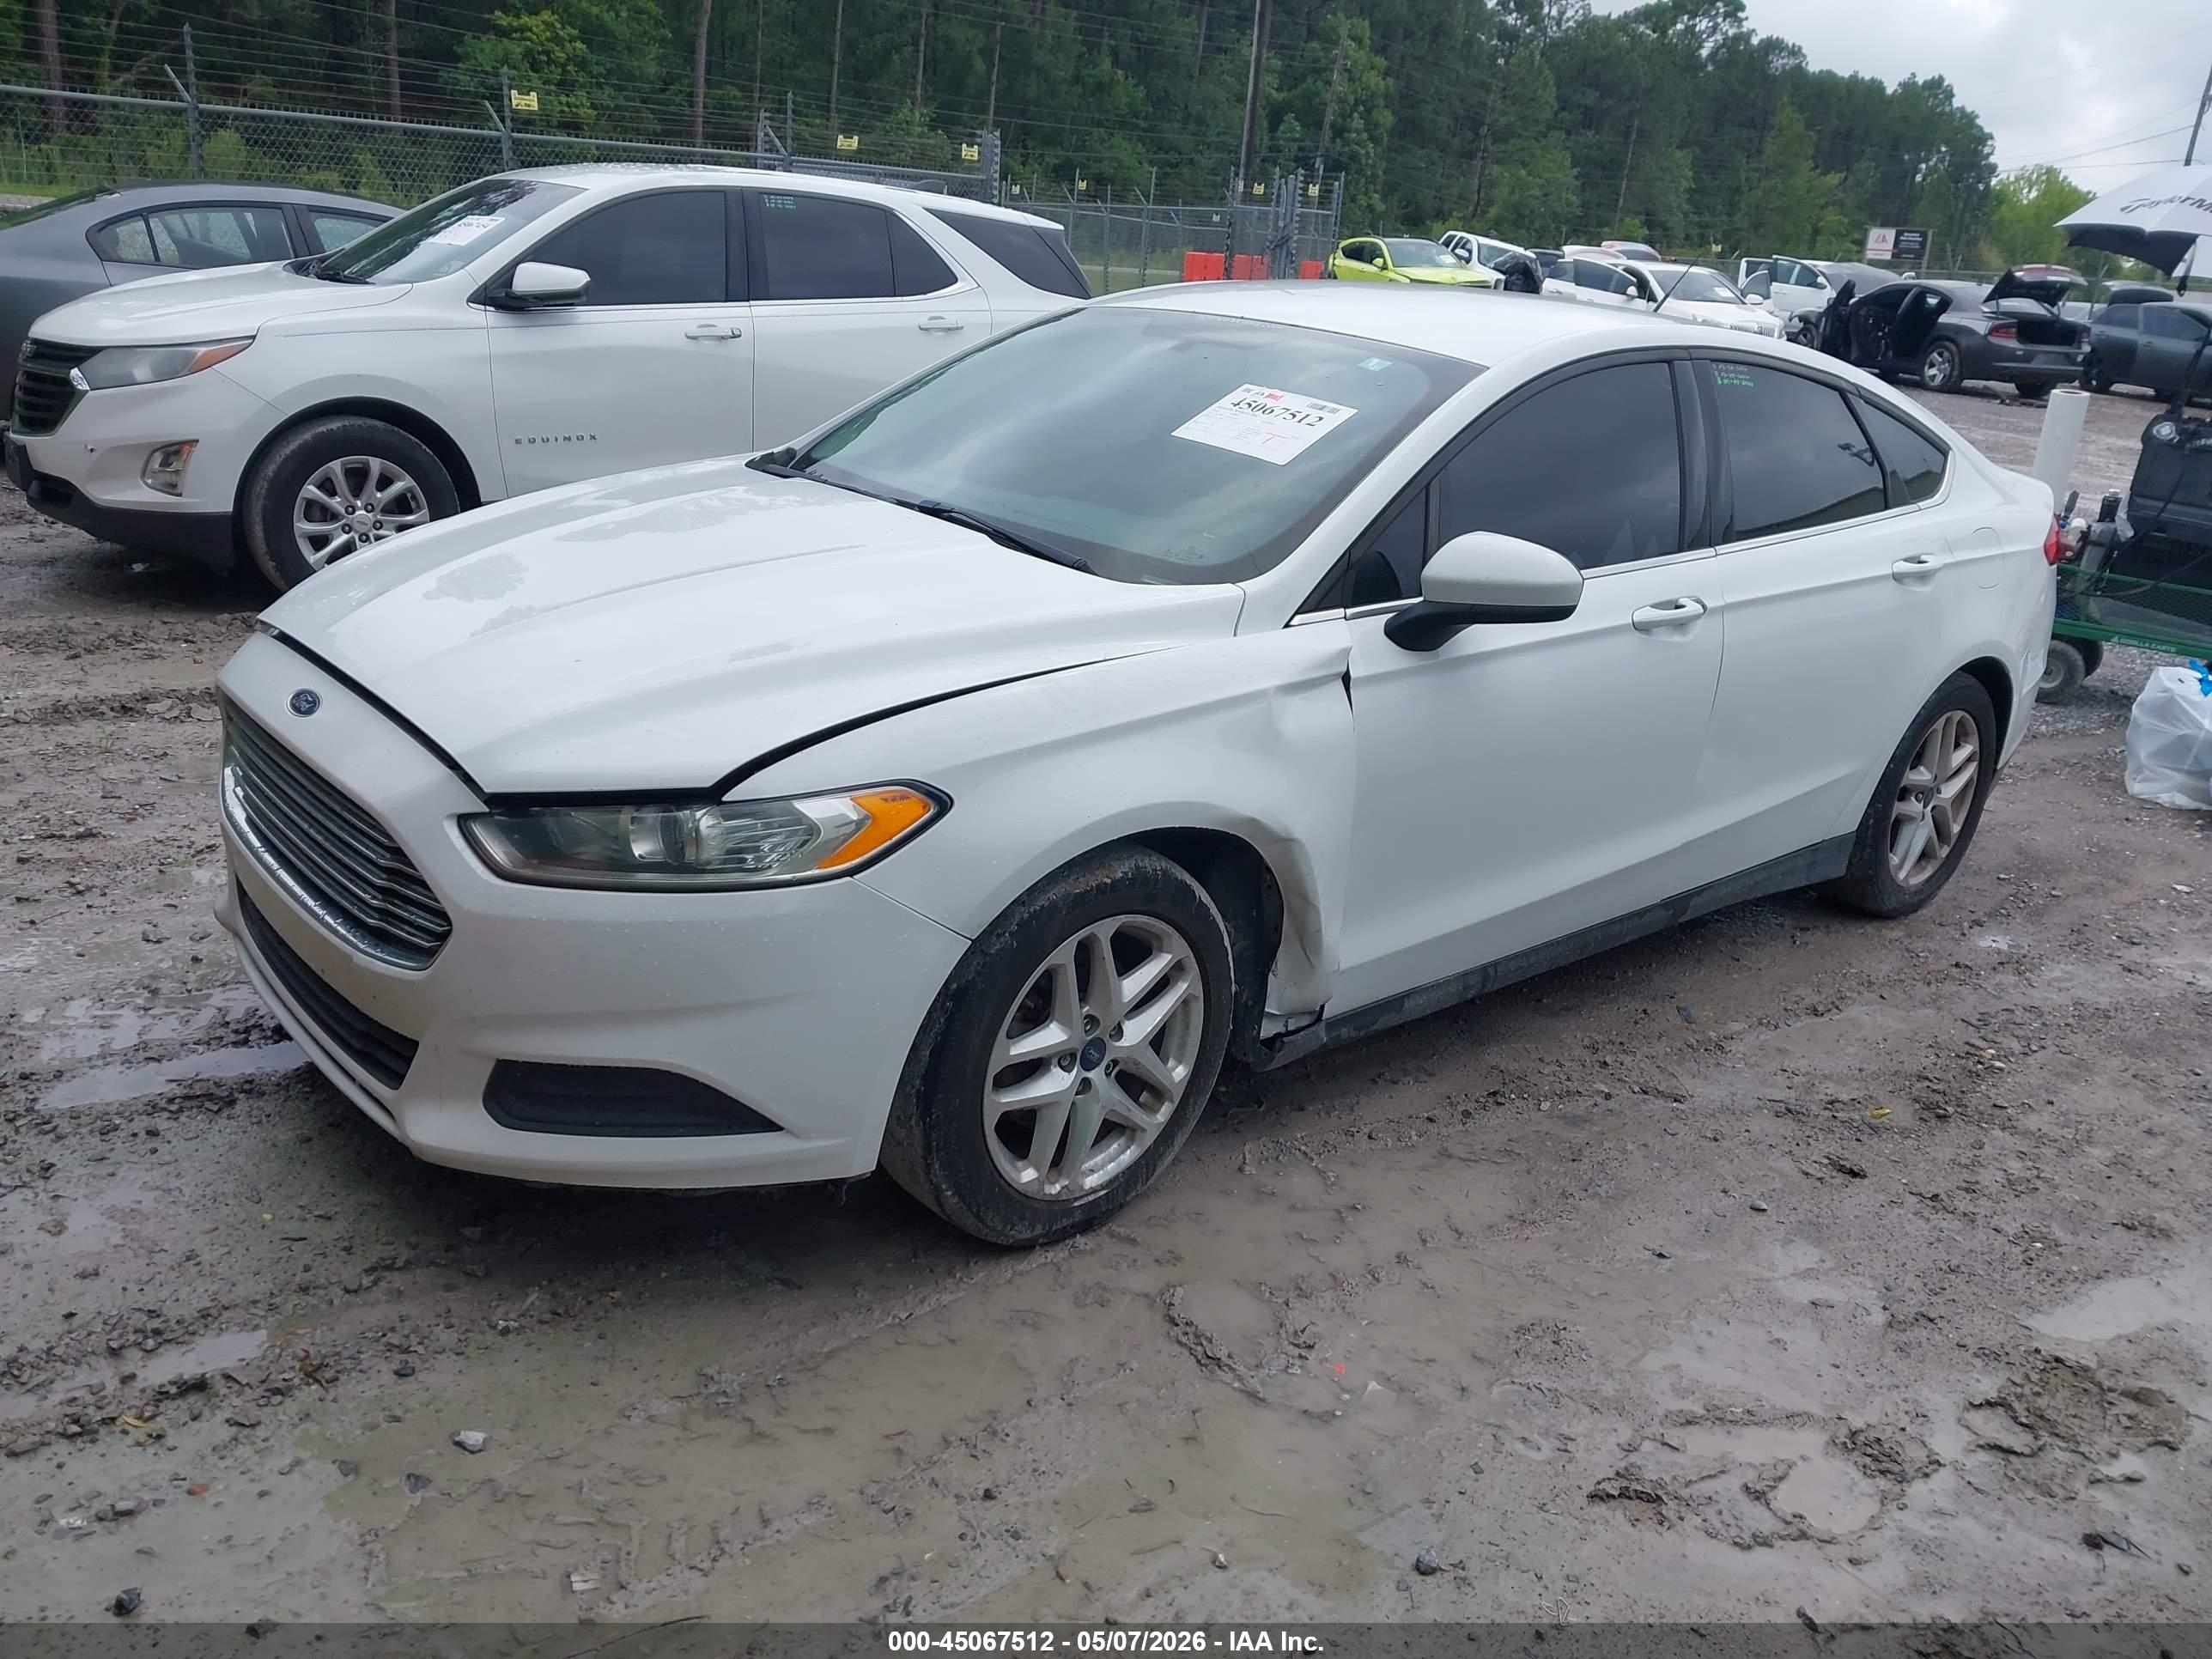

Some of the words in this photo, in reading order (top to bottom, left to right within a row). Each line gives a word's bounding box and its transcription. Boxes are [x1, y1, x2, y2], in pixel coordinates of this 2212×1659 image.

[2119, 191, 2212, 214] TaylorM
[1231, 397, 1325, 427] 45067512
[514, 433, 598, 445] EQUINOX
